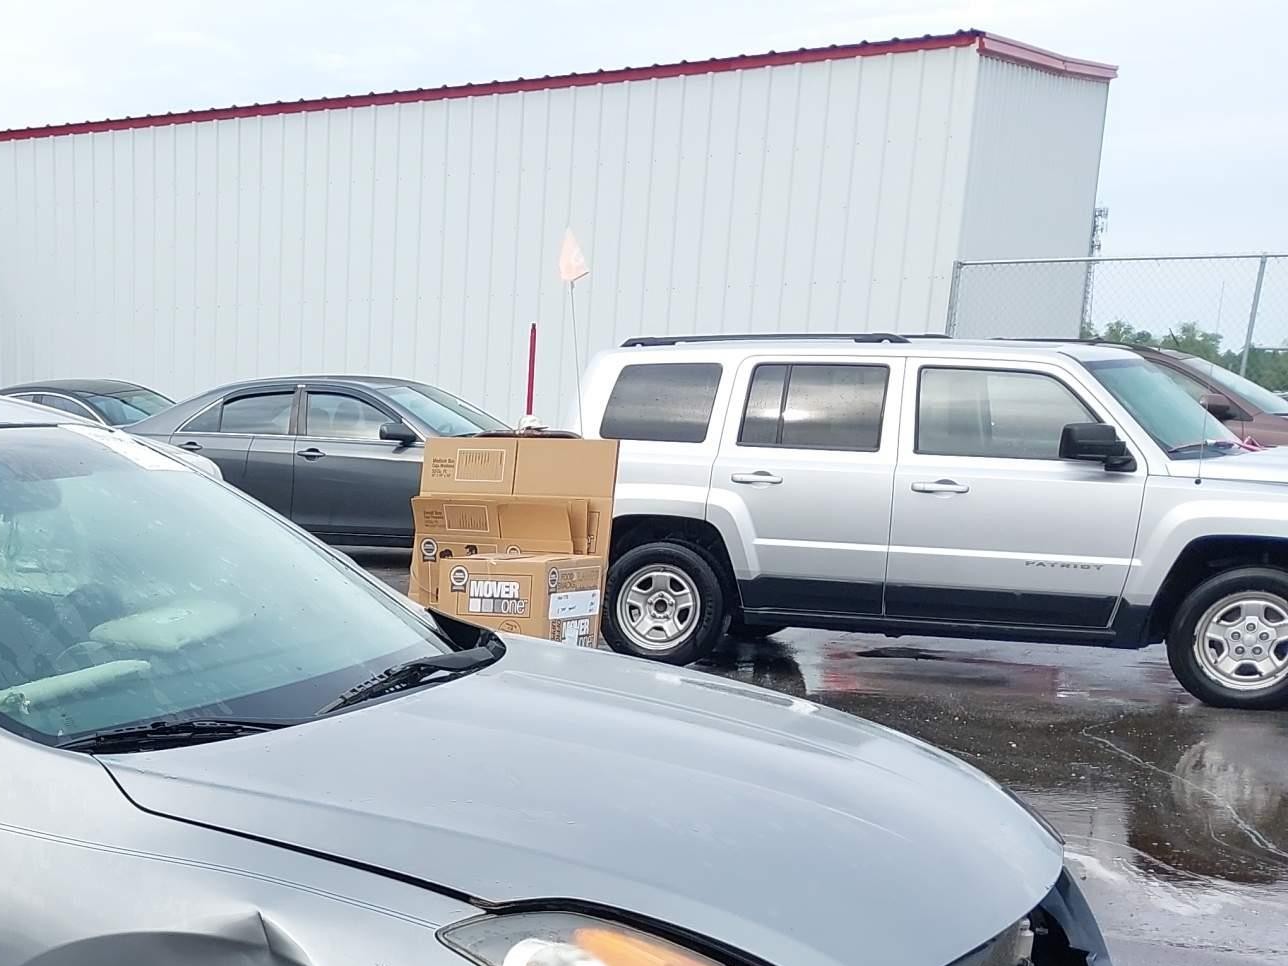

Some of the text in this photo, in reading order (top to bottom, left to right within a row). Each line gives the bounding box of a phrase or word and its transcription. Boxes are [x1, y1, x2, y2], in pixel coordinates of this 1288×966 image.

[1024, 560, 1104, 571] PATRIOT
[469, 580, 520, 598] MOVER
[501, 599, 525, 614] one
